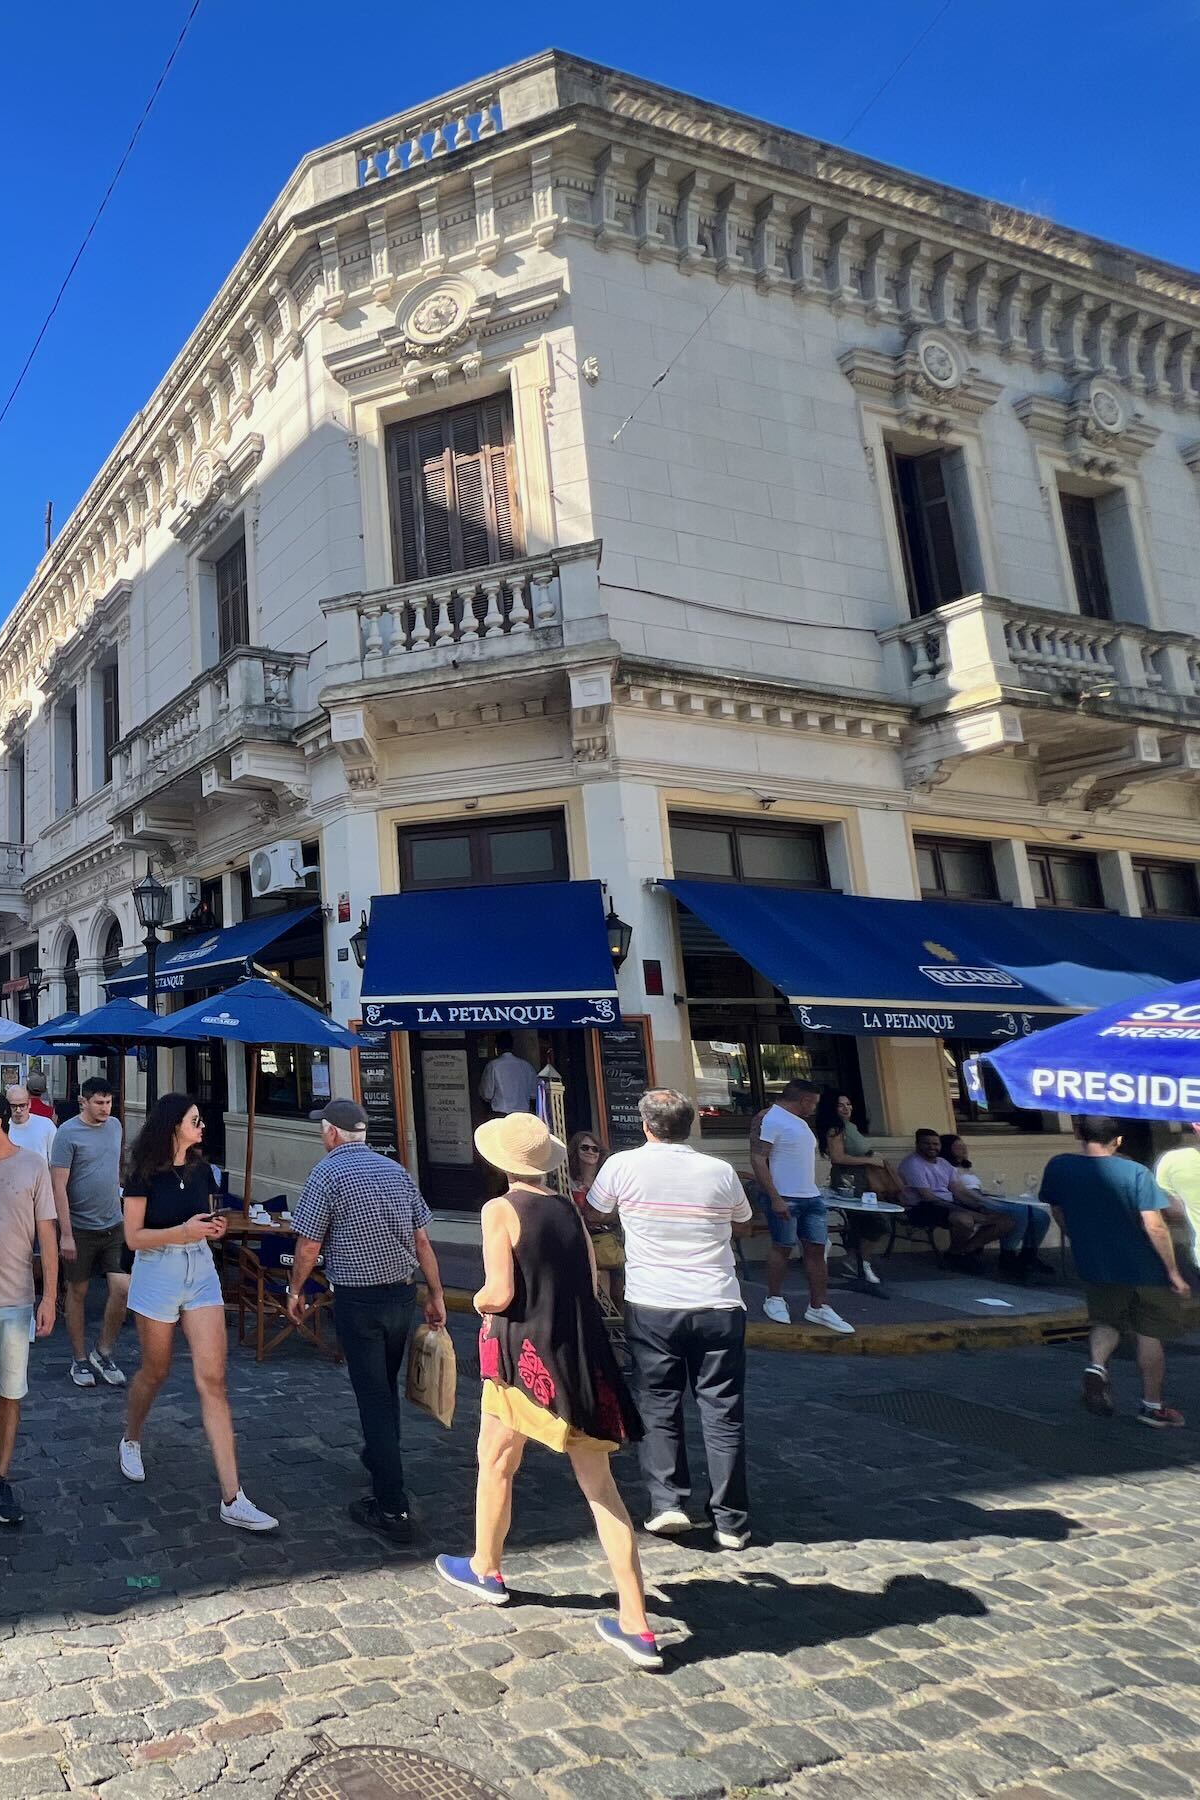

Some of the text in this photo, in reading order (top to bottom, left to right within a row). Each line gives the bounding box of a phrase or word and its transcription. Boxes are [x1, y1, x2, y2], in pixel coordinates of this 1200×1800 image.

[927, 969, 1013, 985] RICARD
[416, 1005, 556, 1025] LA PETANQUE
[862, 1012, 956, 1033] LA PETANQUE
[364, 1092, 390, 1100] QUICHE
